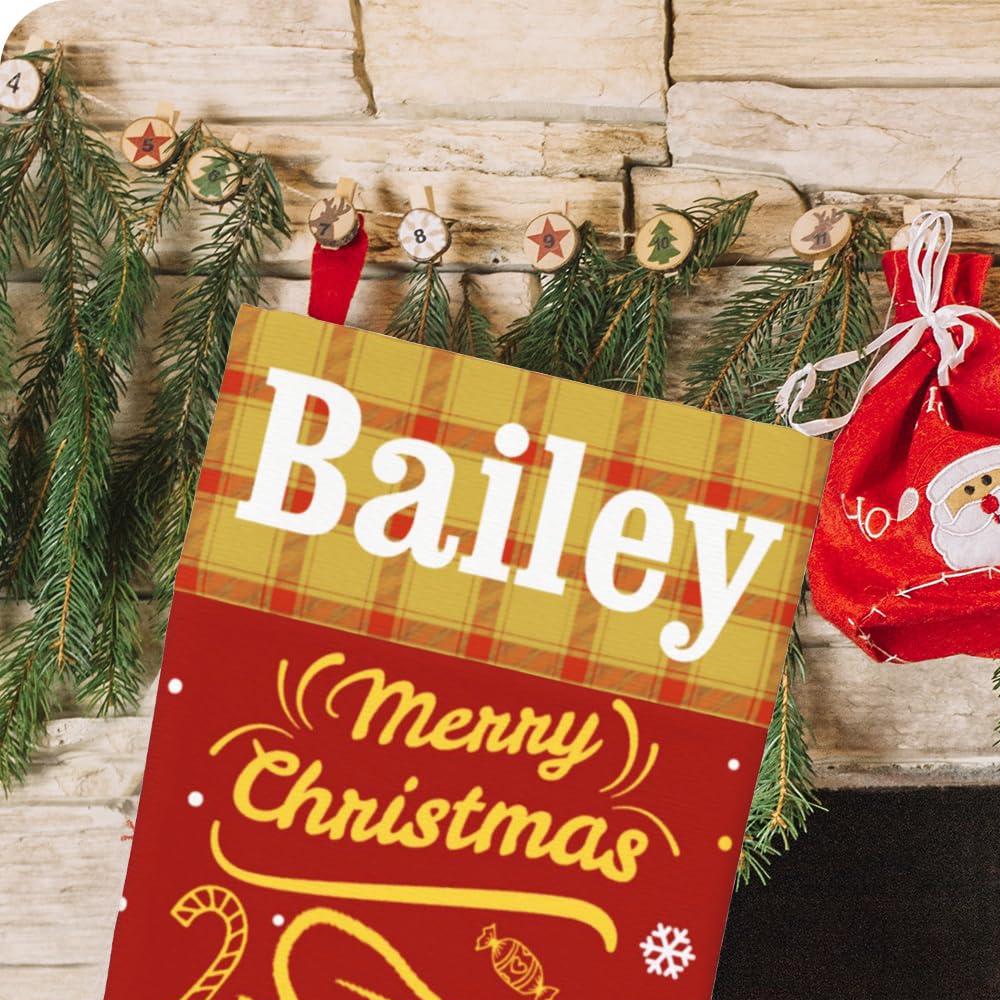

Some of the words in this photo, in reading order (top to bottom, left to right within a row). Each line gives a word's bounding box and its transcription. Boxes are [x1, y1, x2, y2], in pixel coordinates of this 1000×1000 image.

[6, 72, 21, 94] 4
[142, 137, 154, 152] 5
[319, 222, 331, 235] 7
[413, 228, 427, 244] 8
[543, 236, 555, 248] 9
[656, 236, 670, 252] 10
[235, 366, 784, 663] Bailey
[325, 667, 603, 779] Merry
[232, 738, 648, 884] Christmas
